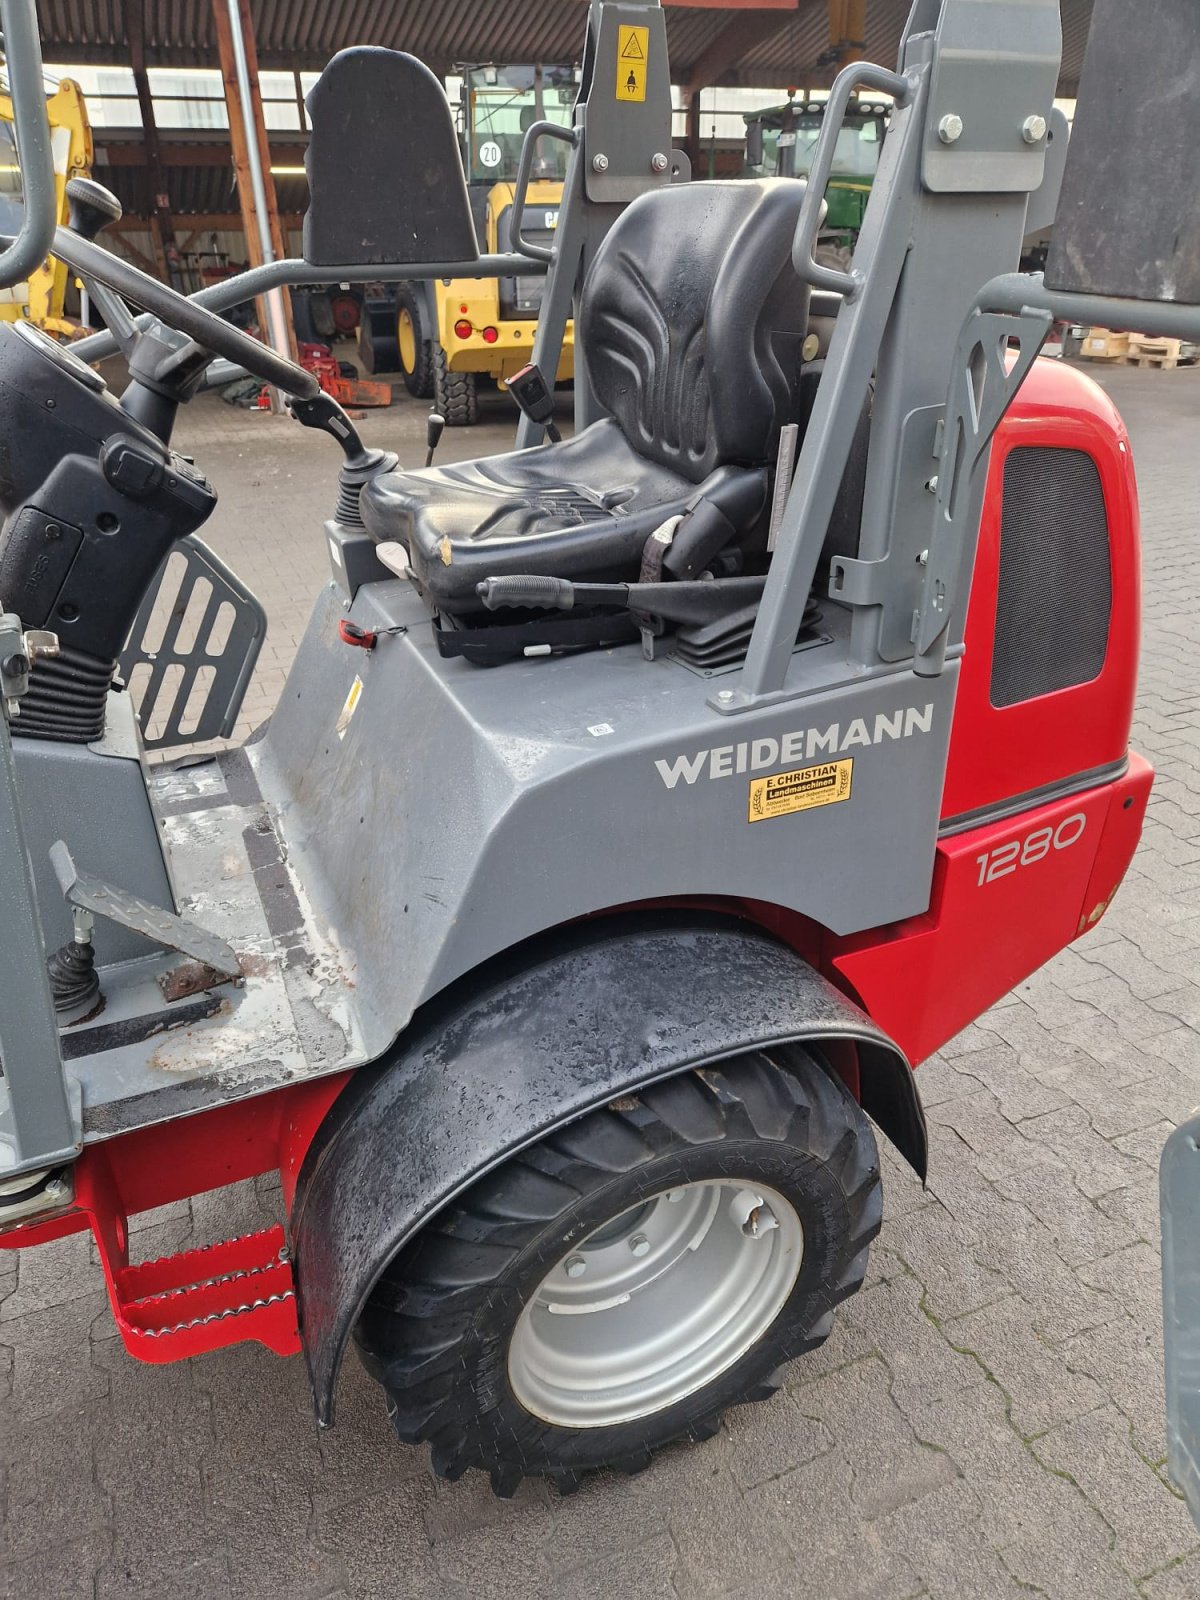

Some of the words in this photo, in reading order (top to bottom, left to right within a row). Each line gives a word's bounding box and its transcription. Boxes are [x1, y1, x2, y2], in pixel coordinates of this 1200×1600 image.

[484, 147, 497, 162] 20
[654, 703, 934, 789] WEIDEMANN
[767, 779, 775, 788] E.
[778, 765, 838, 786] CHRISTIAN
[769, 778, 833, 798] Landmaschinen
[976, 813, 1086, 886] 1280
